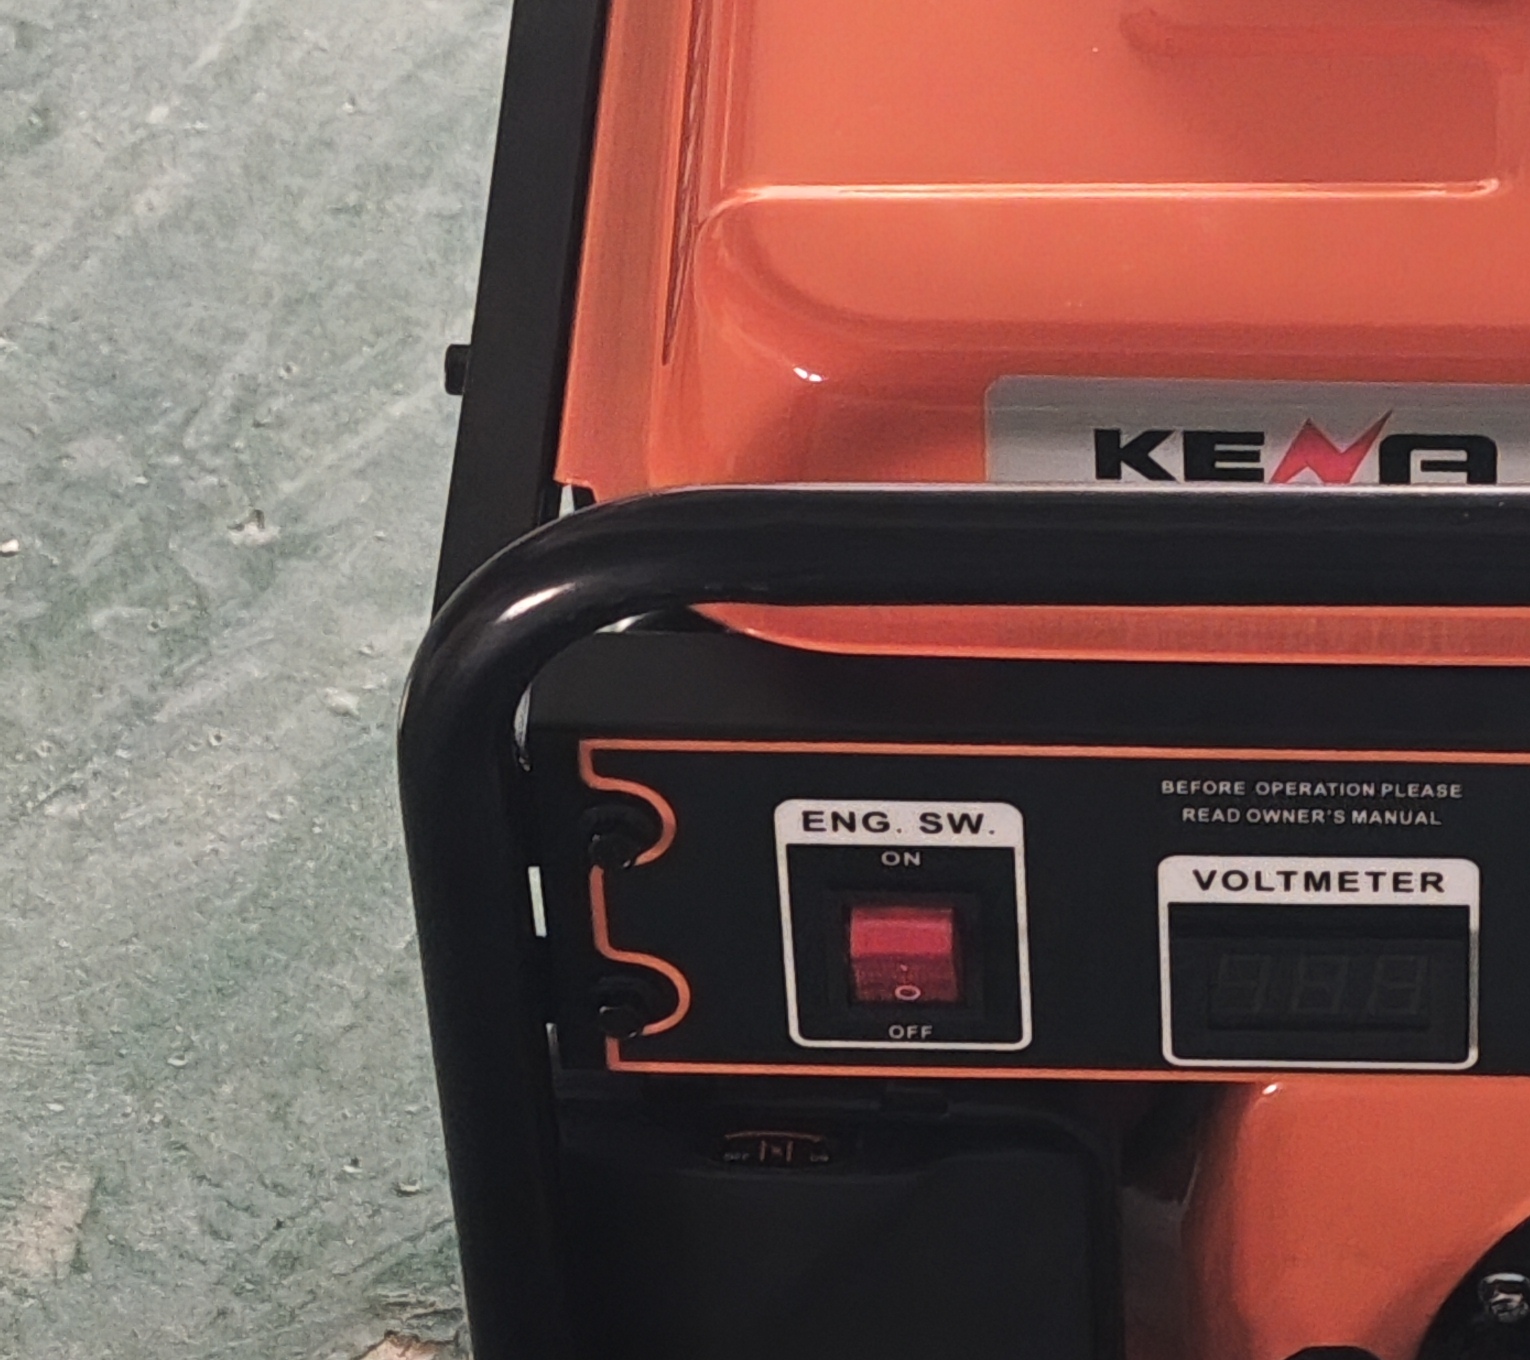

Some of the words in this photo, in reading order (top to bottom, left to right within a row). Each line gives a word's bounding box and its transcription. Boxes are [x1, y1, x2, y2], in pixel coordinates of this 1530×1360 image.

[1161, 780, 1246, 796] BEFORE
[1256, 781, 1375, 798] OPERATION
[1381, 784, 1464, 799] PLEASE
[802, 810, 902, 834] ENG.
[919, 812, 995, 835] SW.
[1182, 808, 1241, 823] READ
[1246, 809, 1346, 825] OWNER'S
[1351, 811, 1442, 826] MANUAL
[881, 851, 921, 866] ON
[1192, 869, 1445, 893] VOLTMETER
[888, 1025, 933, 1040] OFF
